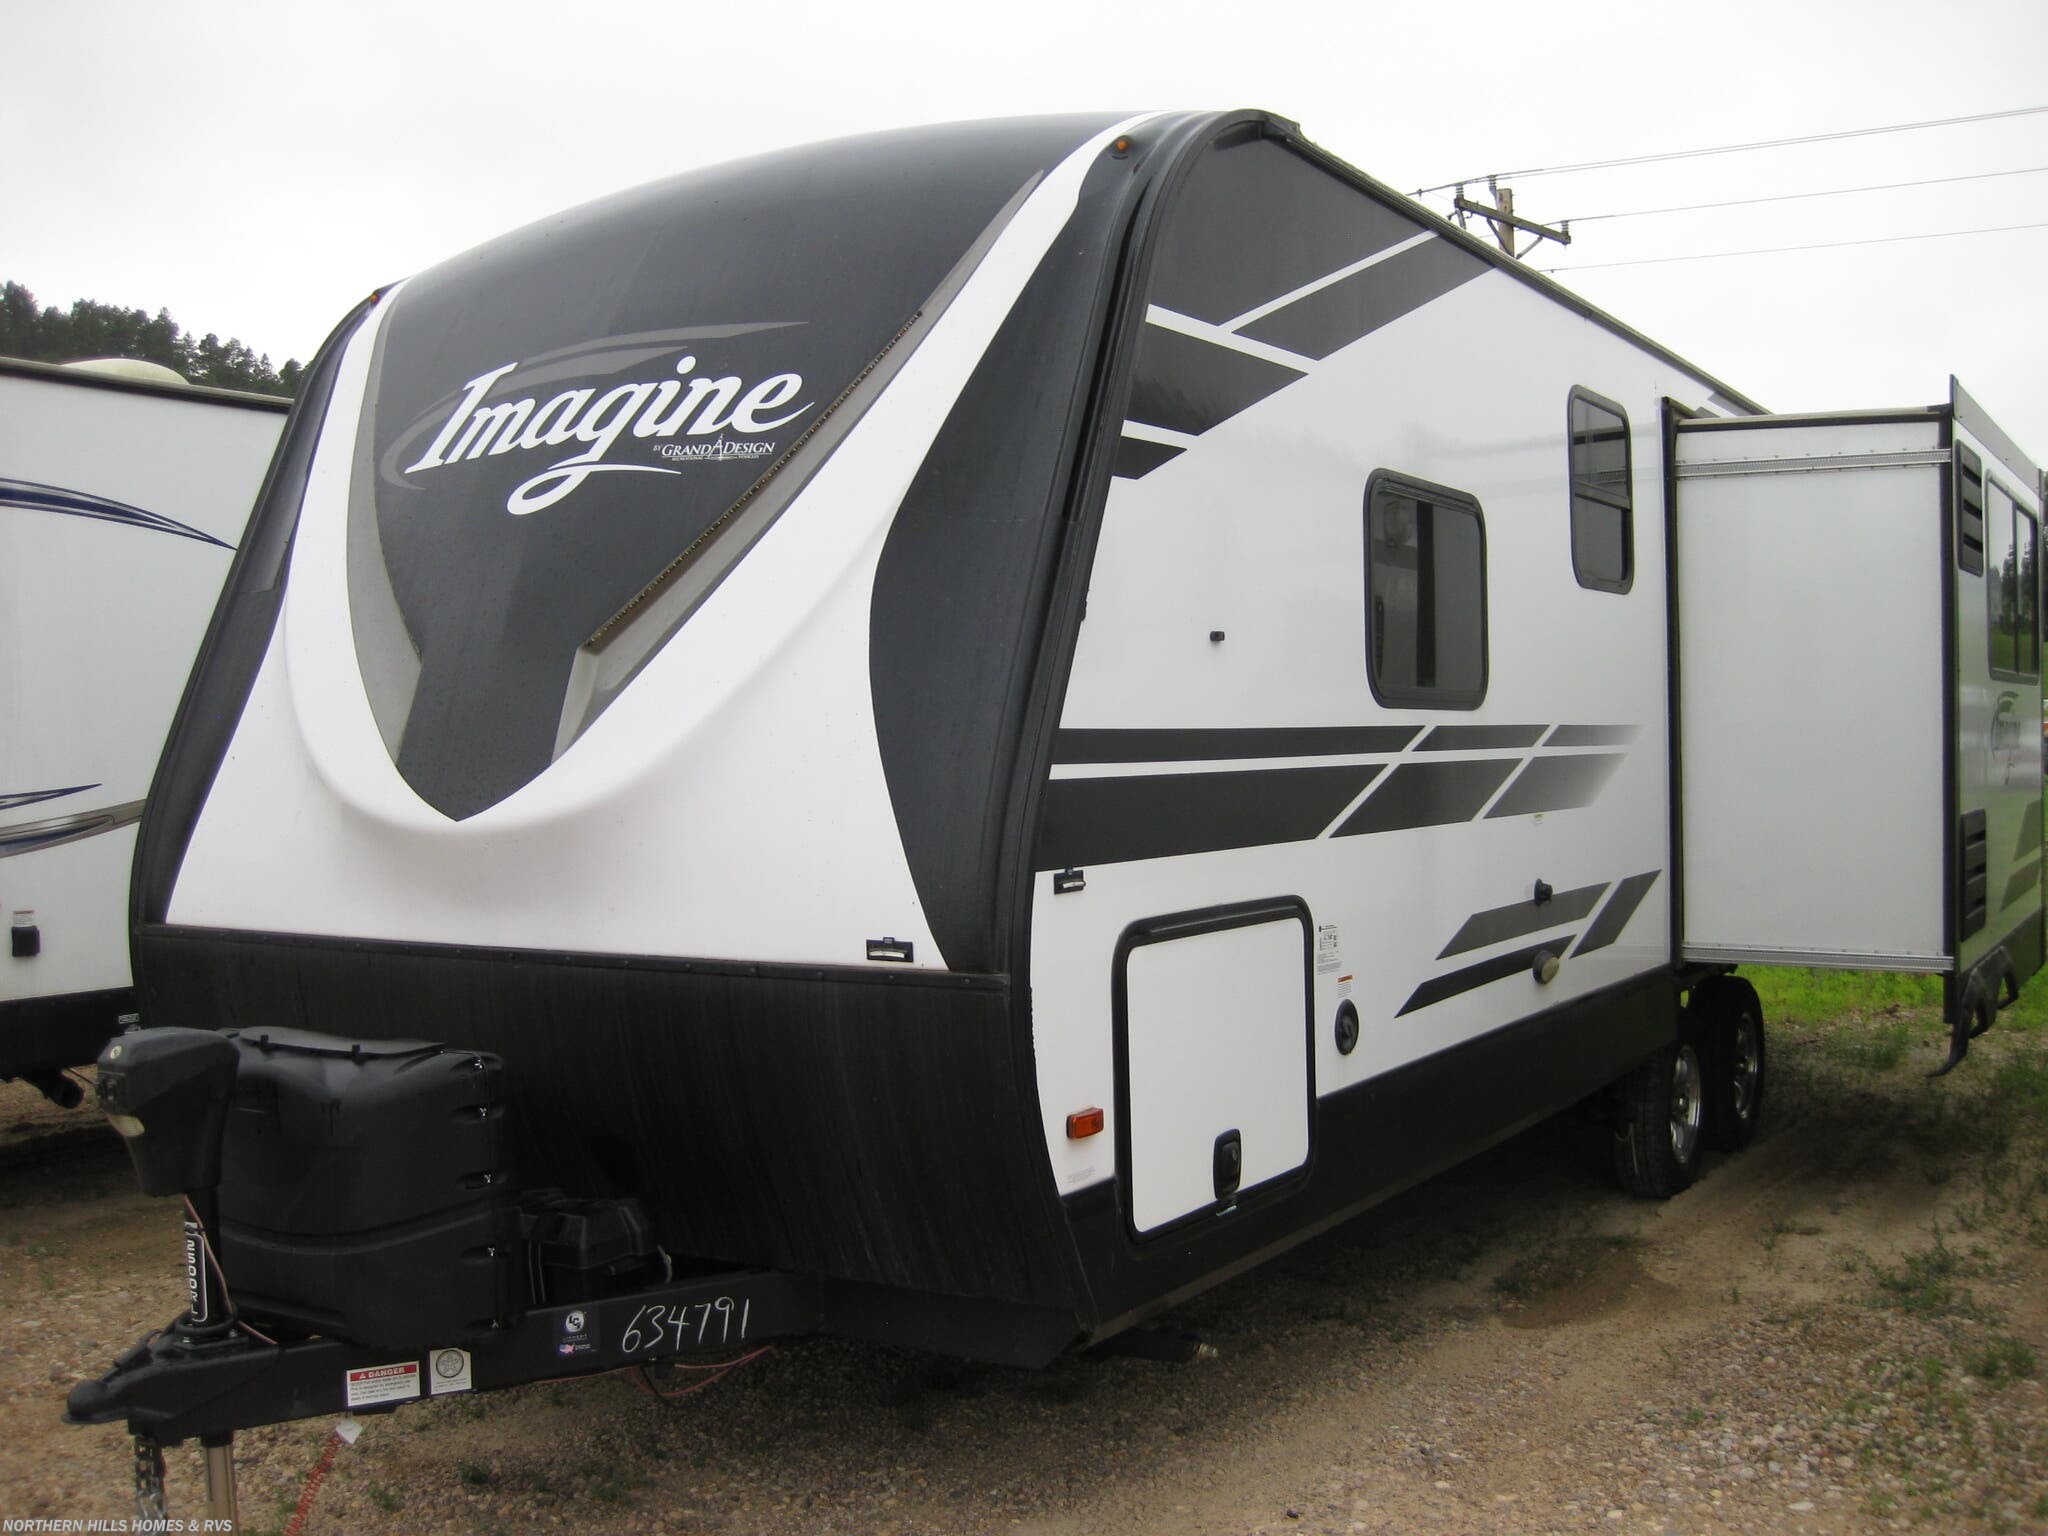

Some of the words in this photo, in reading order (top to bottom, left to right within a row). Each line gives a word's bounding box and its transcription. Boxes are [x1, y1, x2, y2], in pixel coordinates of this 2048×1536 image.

[403, 355, 815, 516] Imagine
[622, 1296, 750, 1353] 634791
[368, 1366, 406, 1378] DANGER
